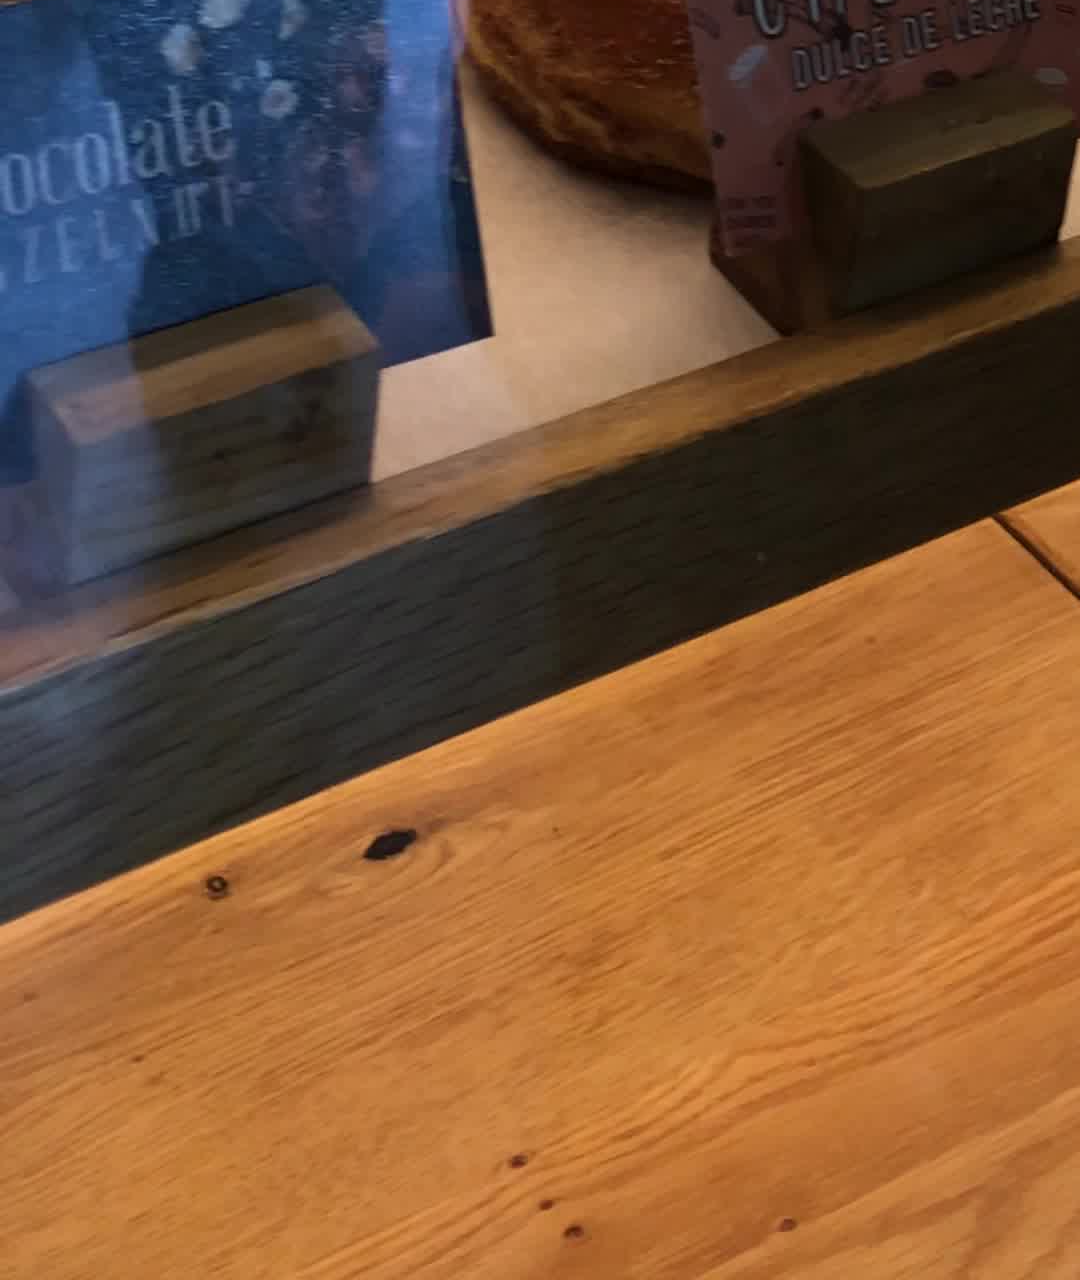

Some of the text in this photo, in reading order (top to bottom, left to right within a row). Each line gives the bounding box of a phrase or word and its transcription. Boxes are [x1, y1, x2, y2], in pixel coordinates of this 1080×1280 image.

[791, 22, 890, 90] DULCE
[902, 8, 940, 59] DE
[0, 85, 235, 217] ocolate
